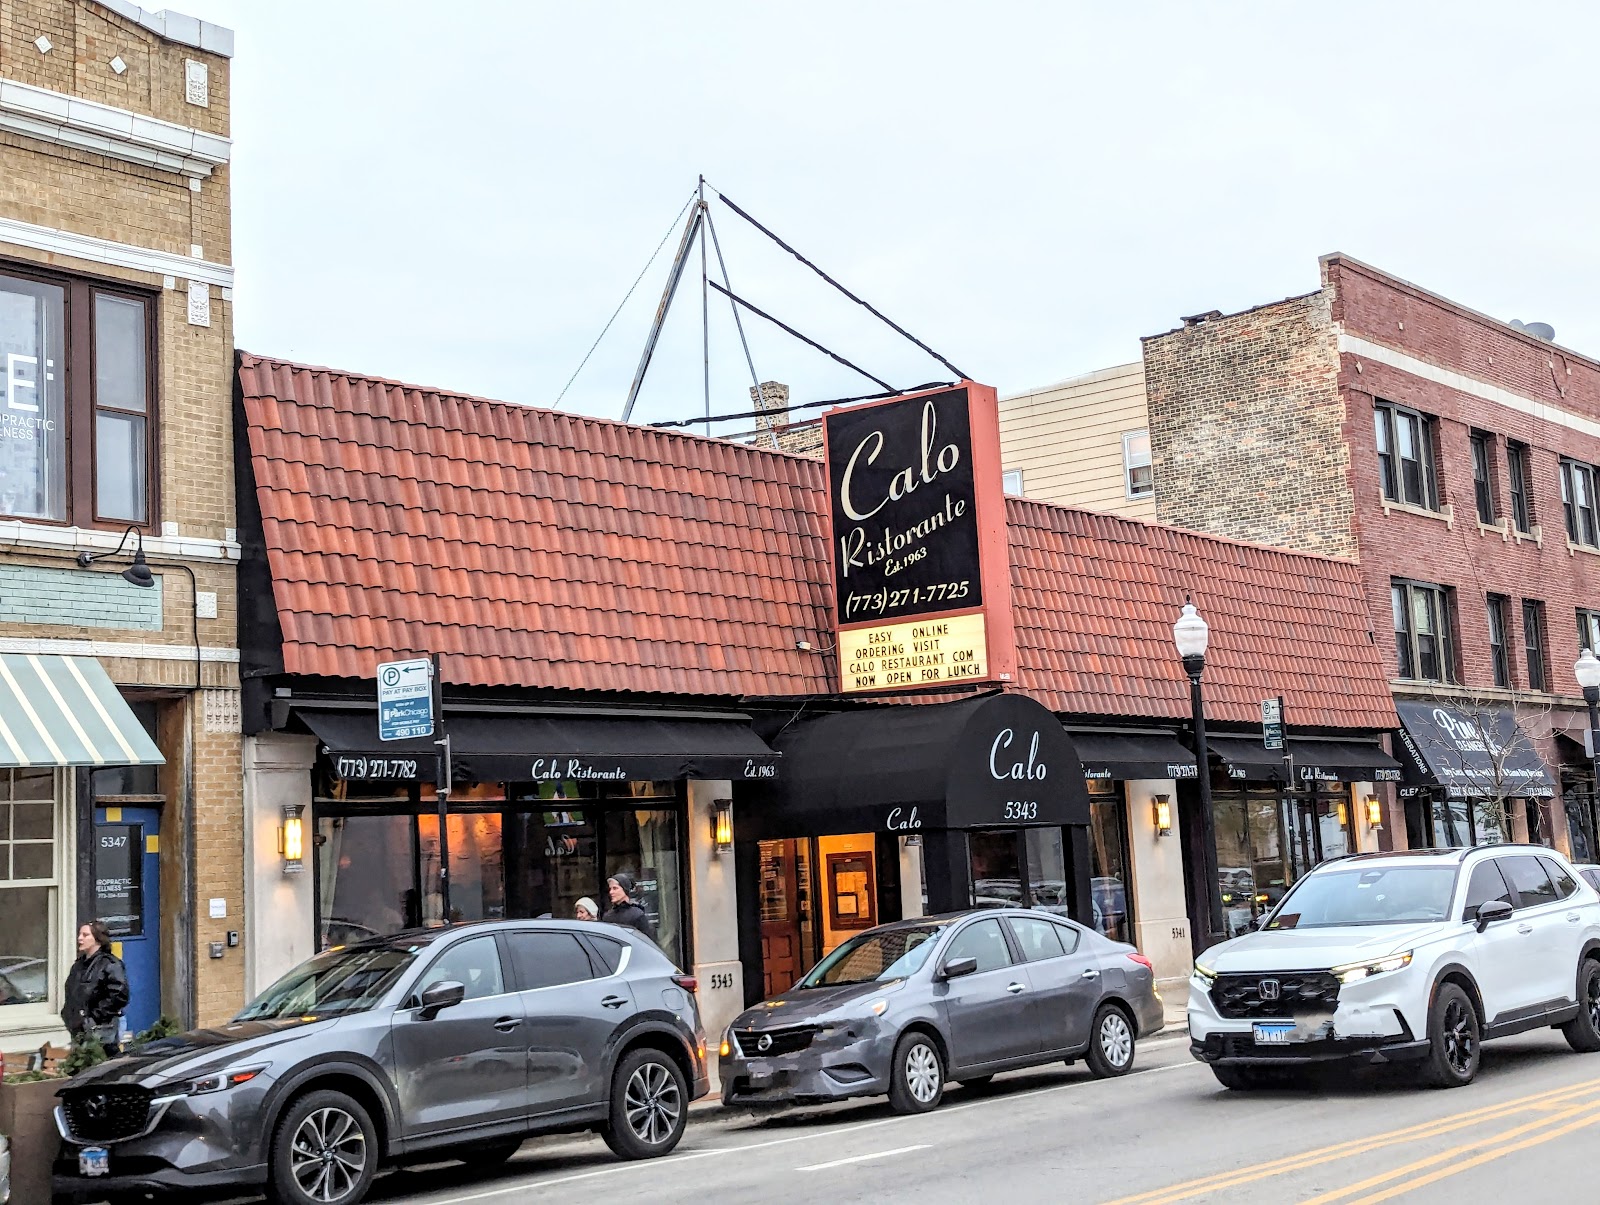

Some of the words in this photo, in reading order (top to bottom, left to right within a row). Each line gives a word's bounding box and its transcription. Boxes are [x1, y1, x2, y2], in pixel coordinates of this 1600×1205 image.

[0, 414, 54, 431] PRACTIC
[0, 426, 33, 440] NESS
[841, 401, 959, 521] Calo
[840, 493, 966, 577] Ristorante
[869, 631, 892, 644] EASY
[912, 624, 948, 638] ONLINE
[856, 644, 904, 658] ORDERING
[914, 639, 940, 652] VISIT
[850, 661, 874, 674] CALO
[882, 653, 944, 670] RESTAURANT
[953, 650, 974, 662] COM
[856, 675, 875, 687] NOW
[886, 671, 912, 684] OPEN
[921, 669, 939, 680] FOR
[947, 664, 980, 677] LUNCH
[395, 728, 410, 737] 490
[412, 726, 426, 735] 110
[989, 728, 1047, 780] Calo
[1398, 728, 1428, 774] ALTERATIONS
[337, 756, 367, 778] (773)
[370, 759, 417, 778] 271-7782
[531, 758, 561, 779] Calo
[567, 758, 626, 779] Ristorante
[886, 806, 922, 830] Calo
[1004, 801, 1037, 820] 5343
[101, 836, 127, 848] 5347
[711, 973, 732, 989] 5343
